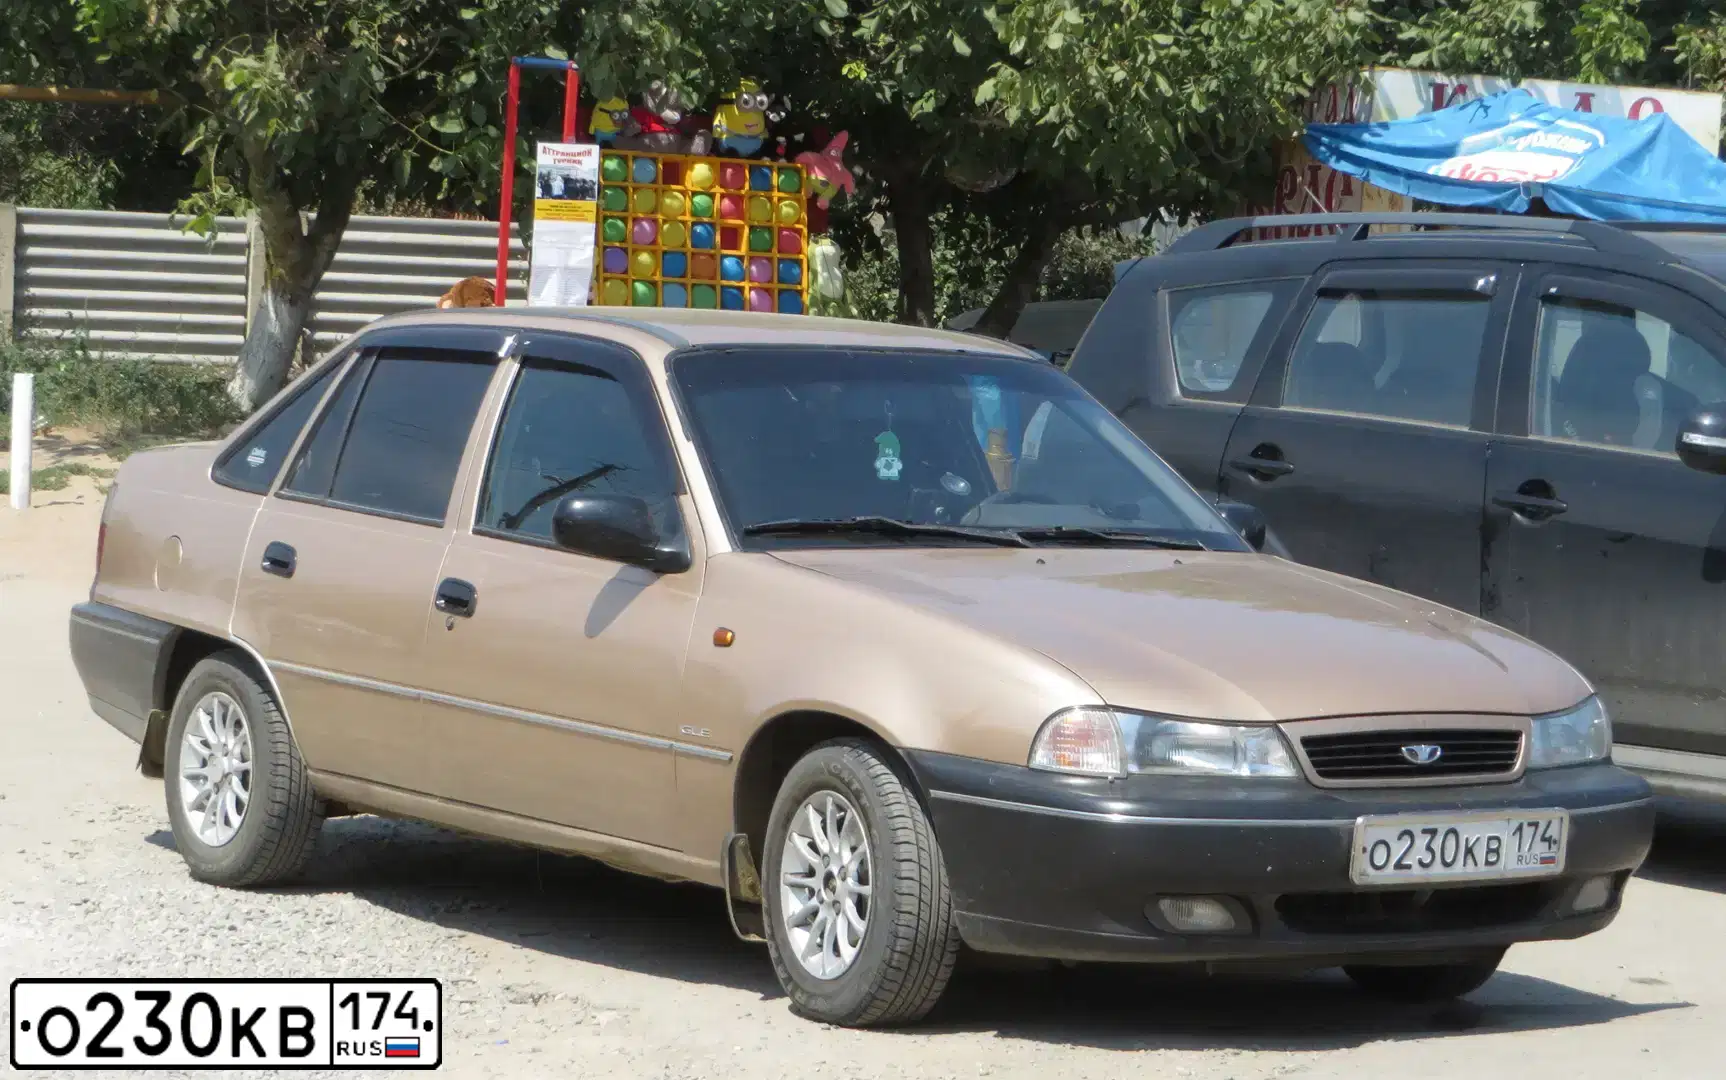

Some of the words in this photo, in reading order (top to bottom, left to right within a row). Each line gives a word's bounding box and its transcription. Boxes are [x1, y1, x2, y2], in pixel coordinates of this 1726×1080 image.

[680, 724, 712, 738] GLE
[1369, 827, 1502, 871] О230КВ
[1511, 819, 1552, 853] 174
[1516, 852, 1539, 866] RUS
